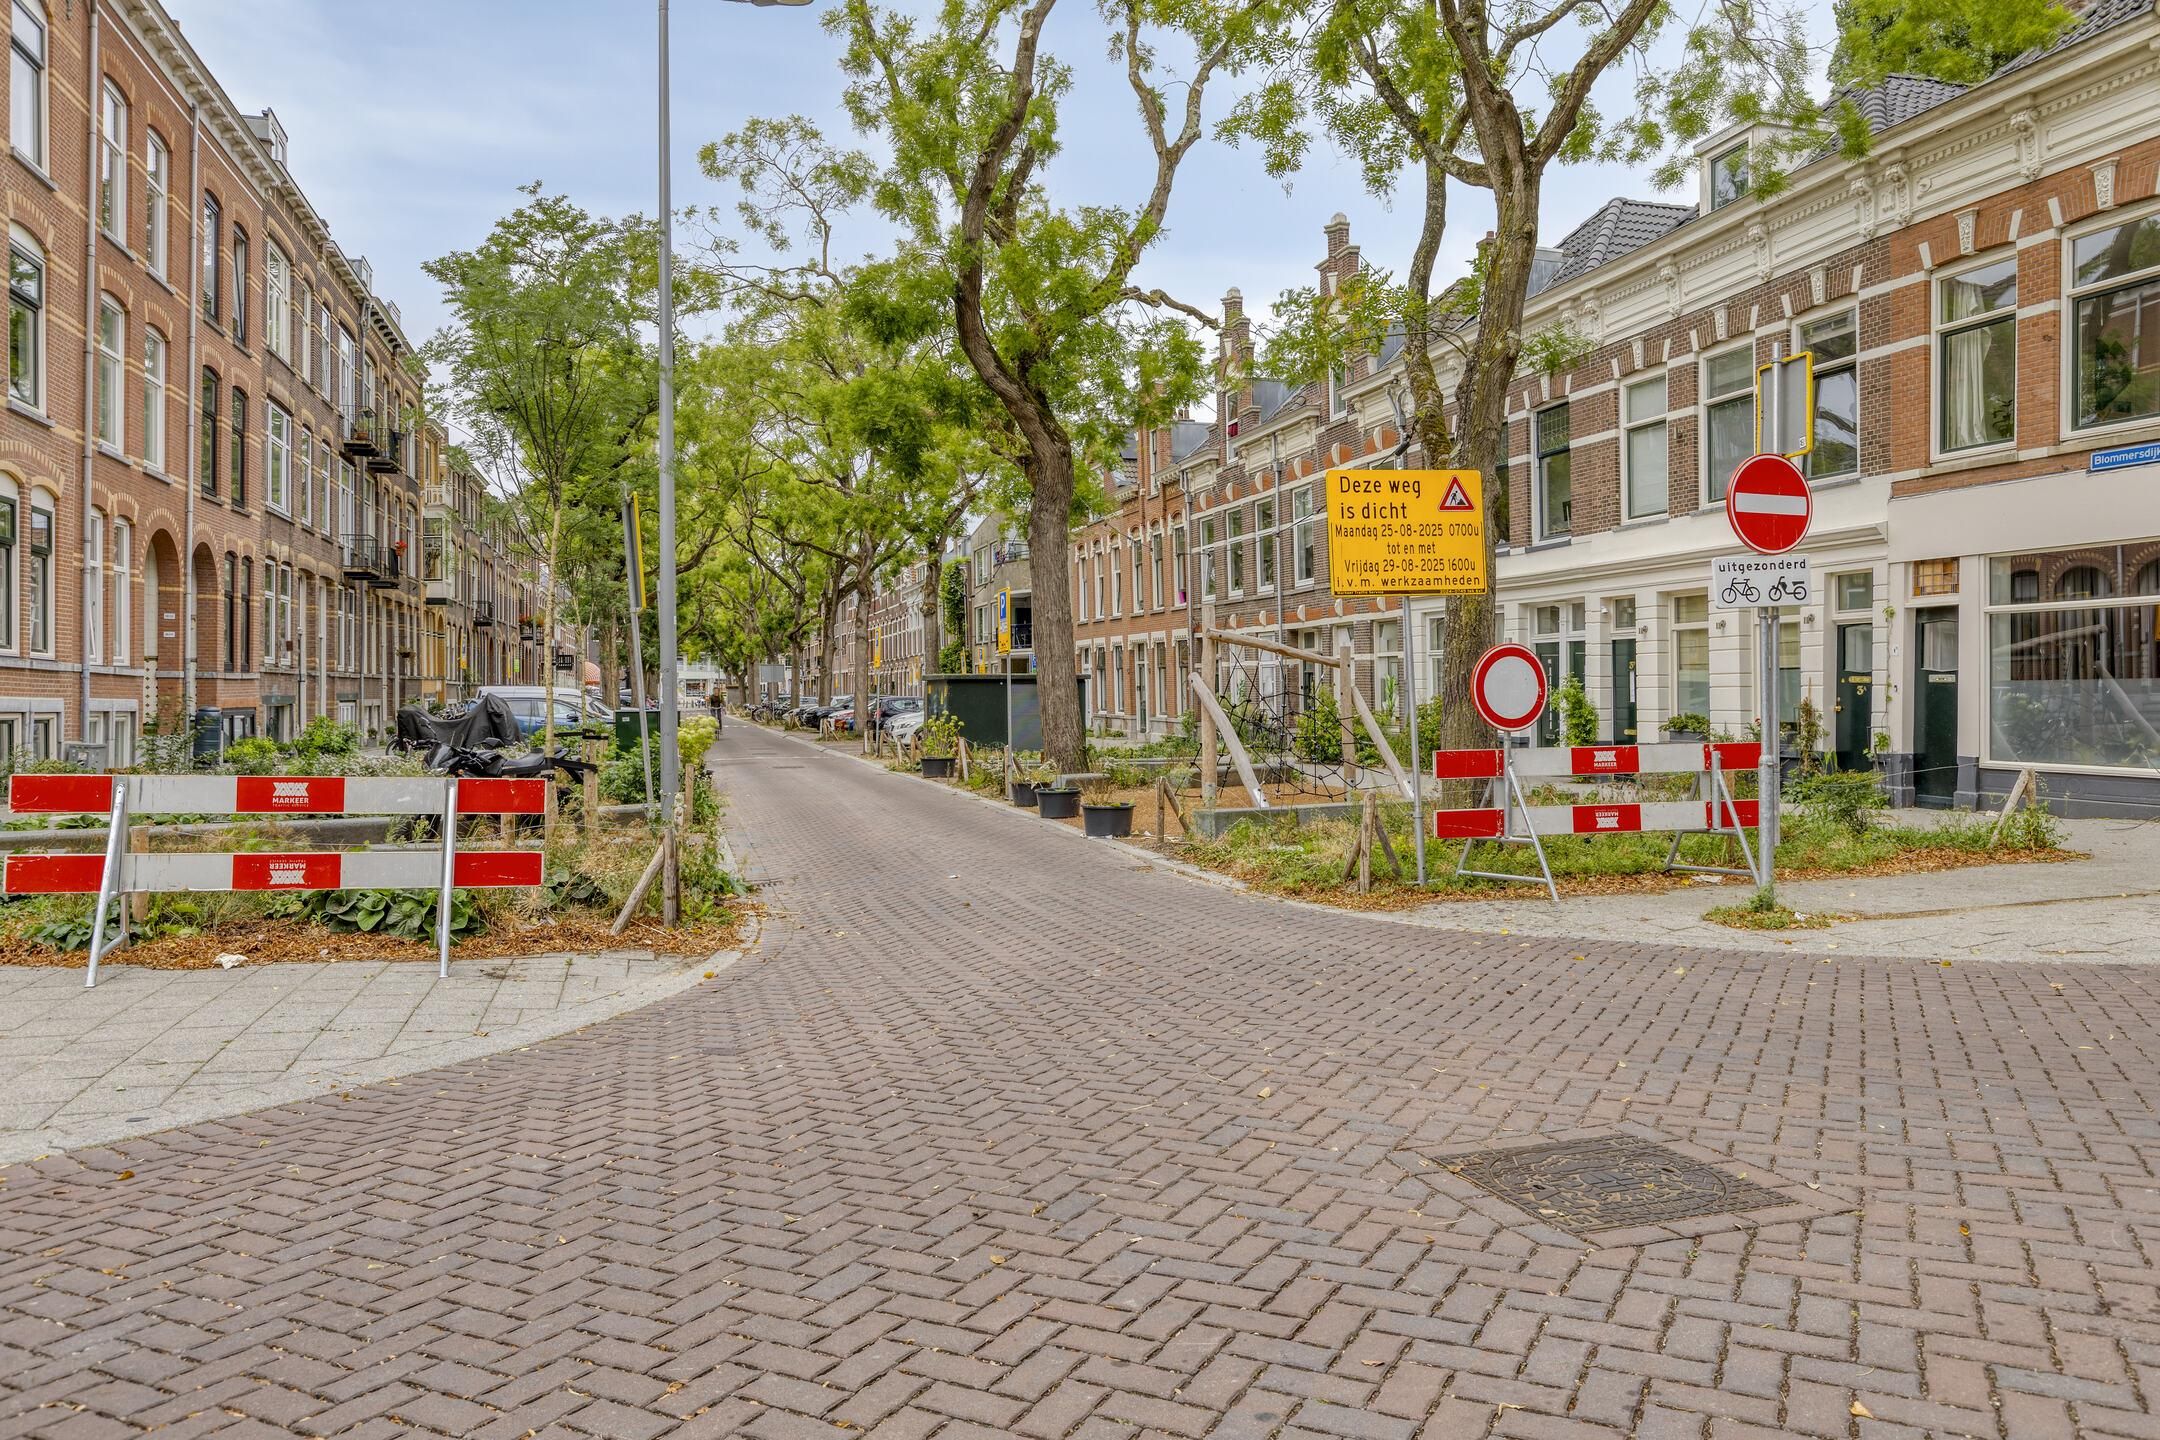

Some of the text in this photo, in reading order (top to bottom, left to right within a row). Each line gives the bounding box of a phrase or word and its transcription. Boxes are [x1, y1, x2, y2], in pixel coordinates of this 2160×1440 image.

[1340, 476, 1421, 499] Deze weg
[1341, 502, 1408, 519] is dicht
[1335, 523, 1479, 541] Maandag 25-08-2025 0700u
[1387, 542, 1436, 555] tot en met
[1344, 558, 1476, 577] Vrijdag 29-08-2025 1600u
[1718, 559, 1807, 574] uitgezonderd
[1381, 575, 1480, 587] werkzaamheden
